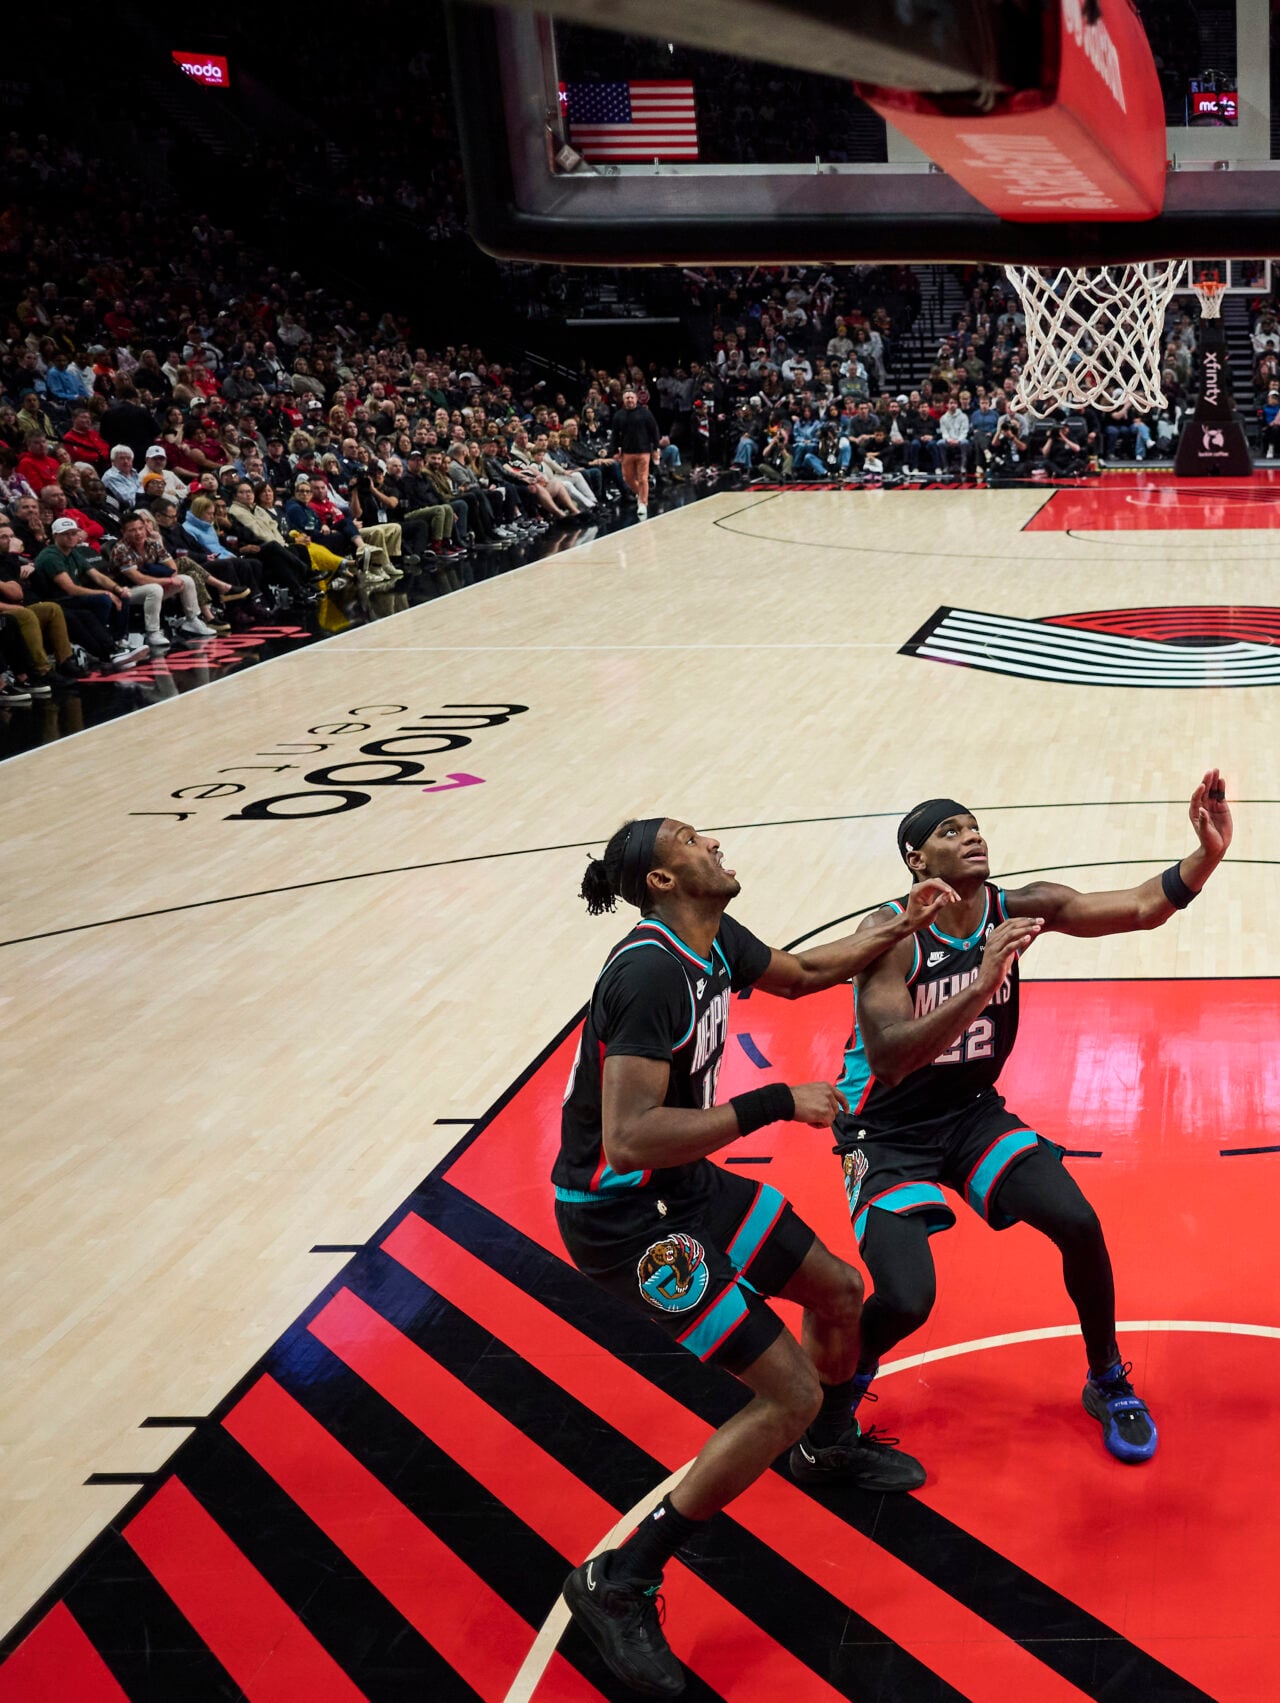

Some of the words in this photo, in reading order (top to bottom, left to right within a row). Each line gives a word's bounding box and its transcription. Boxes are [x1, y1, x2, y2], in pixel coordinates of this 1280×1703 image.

[181, 63, 222, 78] moda
[1203, 352, 1222, 406] xfinity
[128, 704, 409, 822] center
[222, 704, 530, 821] moda
[930, 951, 945, 961] NIKE
